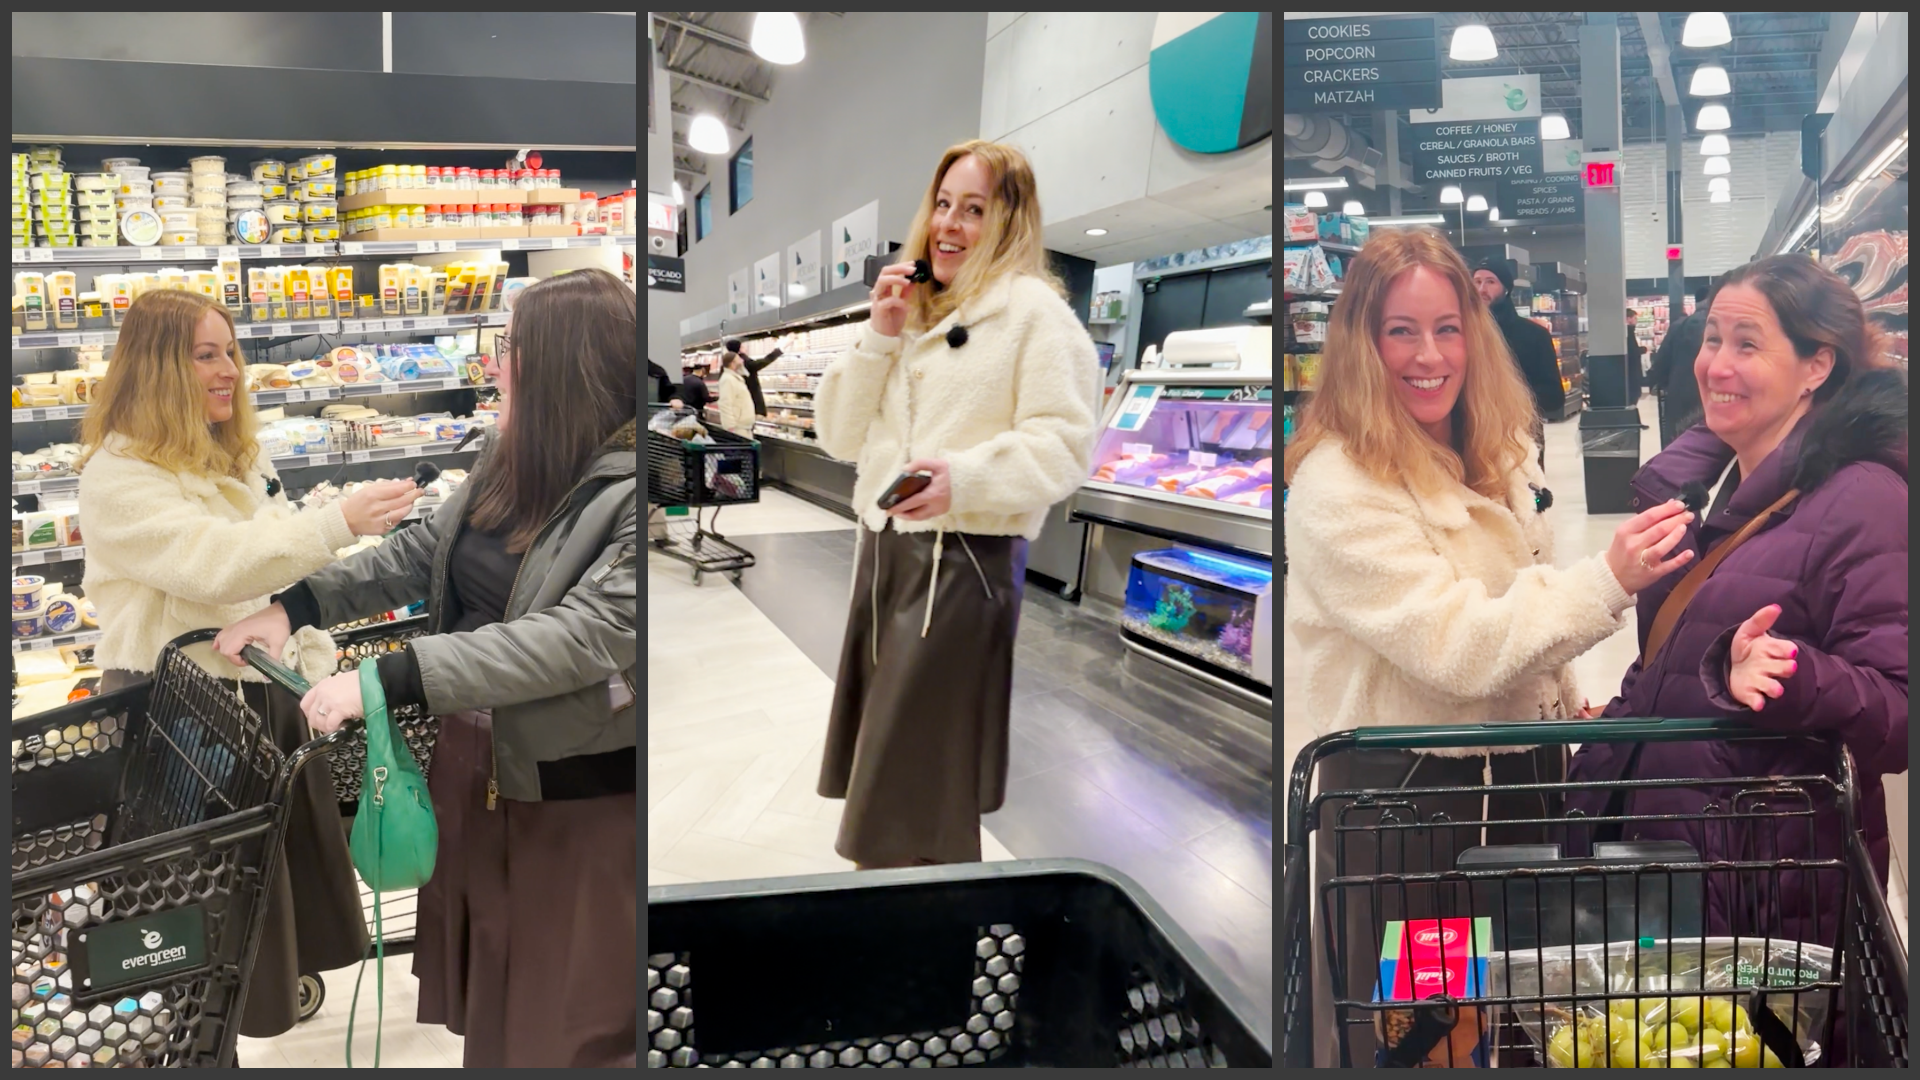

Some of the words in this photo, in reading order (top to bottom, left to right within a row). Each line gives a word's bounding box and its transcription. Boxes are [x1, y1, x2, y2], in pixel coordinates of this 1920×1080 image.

[1308, 24, 1371, 39] COOKIES
[1306, 46, 1376, 61] POPCORN
[1304, 68, 1380, 83] CRACKERS
[1314, 90, 1374, 104] MATZAH
[1436, 126, 1472, 136] COFFEE
[1484, 123, 1517, 133] HONEY
[1420, 141, 1455, 150] CEREAL
[1464, 138, 1509, 148] GRANOLA
[1511, 136, 1536, 146] BARS
[1438, 154, 1476, 164] SAUCES
[1486, 152, 1520, 162] BROTH
[1426, 169, 1466, 178] CANNED
[1468, 167, 1502, 176] FRUITS
[1512, 166, 1532, 174] VEG
[1545, 174, 1578, 182] COOKING
[1588, 163, 1614, 186] EXIT
[648, 268, 682, 280] PESCADO
[122, 945, 186, 970] evergreen
